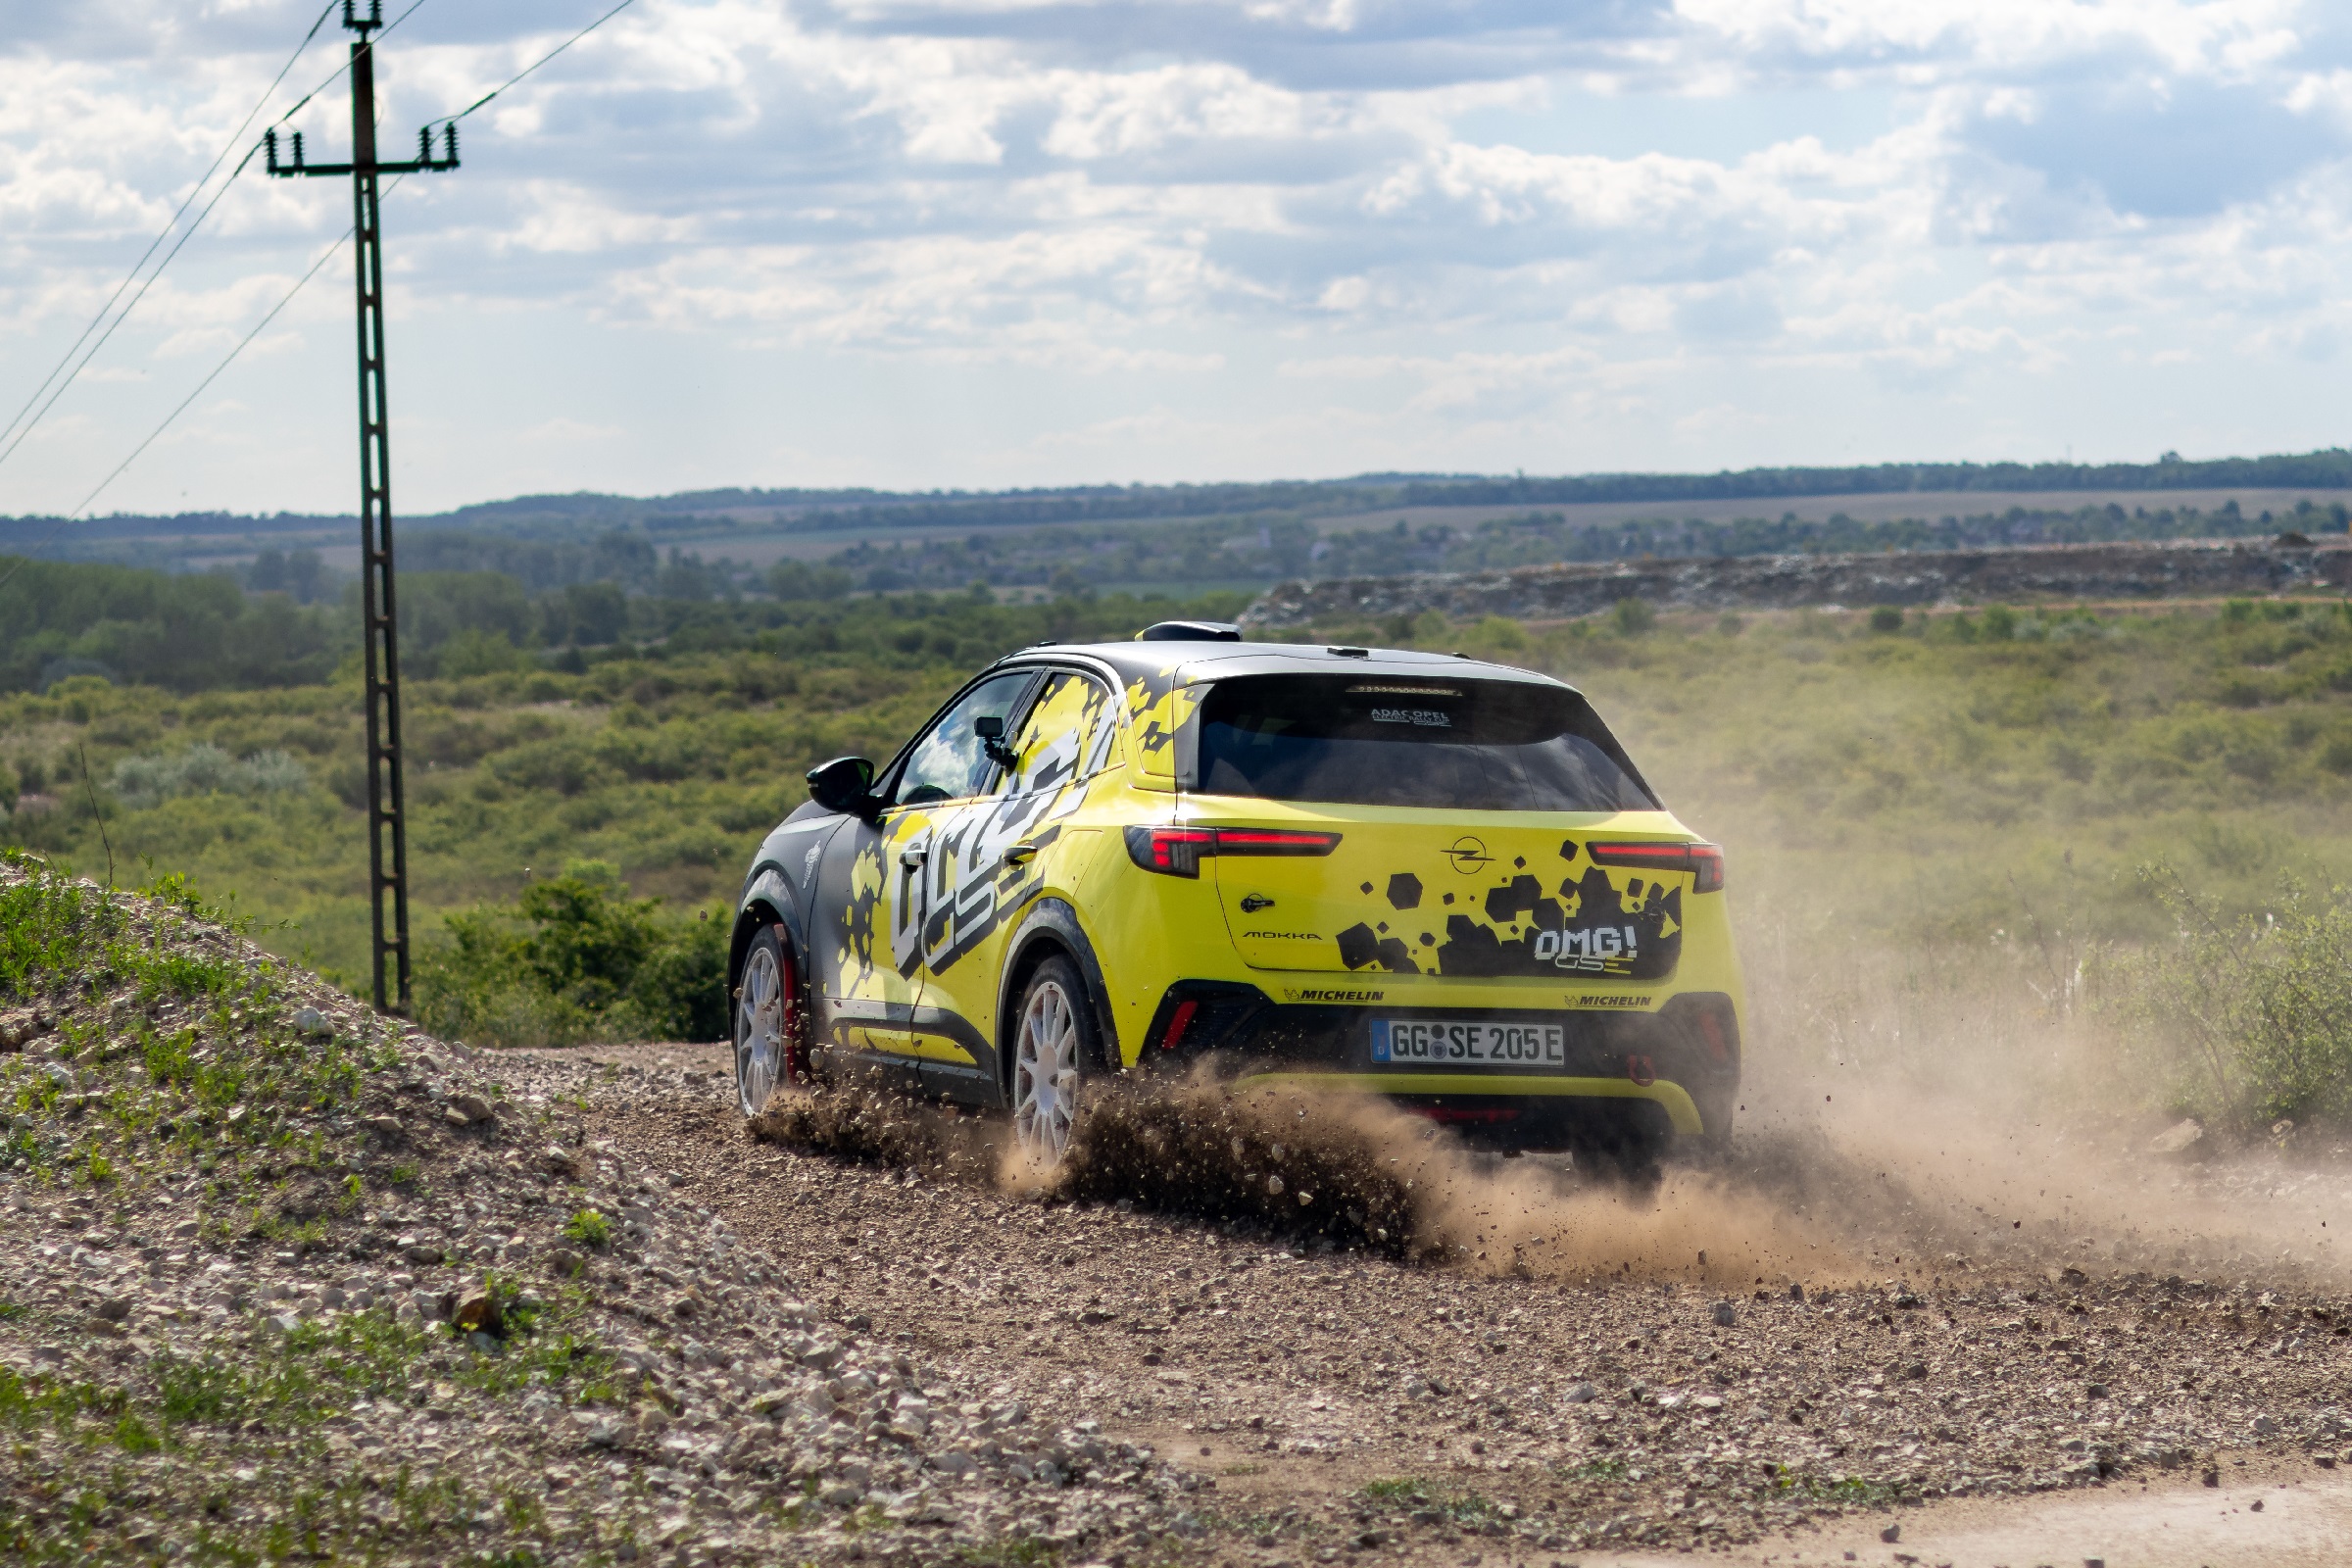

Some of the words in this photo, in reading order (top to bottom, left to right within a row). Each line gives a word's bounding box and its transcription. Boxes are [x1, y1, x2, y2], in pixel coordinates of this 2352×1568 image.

[1412, 710, 1448, 719] OPEL
[1243, 931, 1323, 941] MOKKA
[1534, 925, 1638, 960] OMG!
[1554, 954, 1635, 975] GSE
[1300, 989, 1385, 1002] MICHELIN
[1580, 996, 1652, 1007] MICHELIN
[1392, 1024, 1429, 1057] GG
[1448, 1026, 1485, 1059] SE
